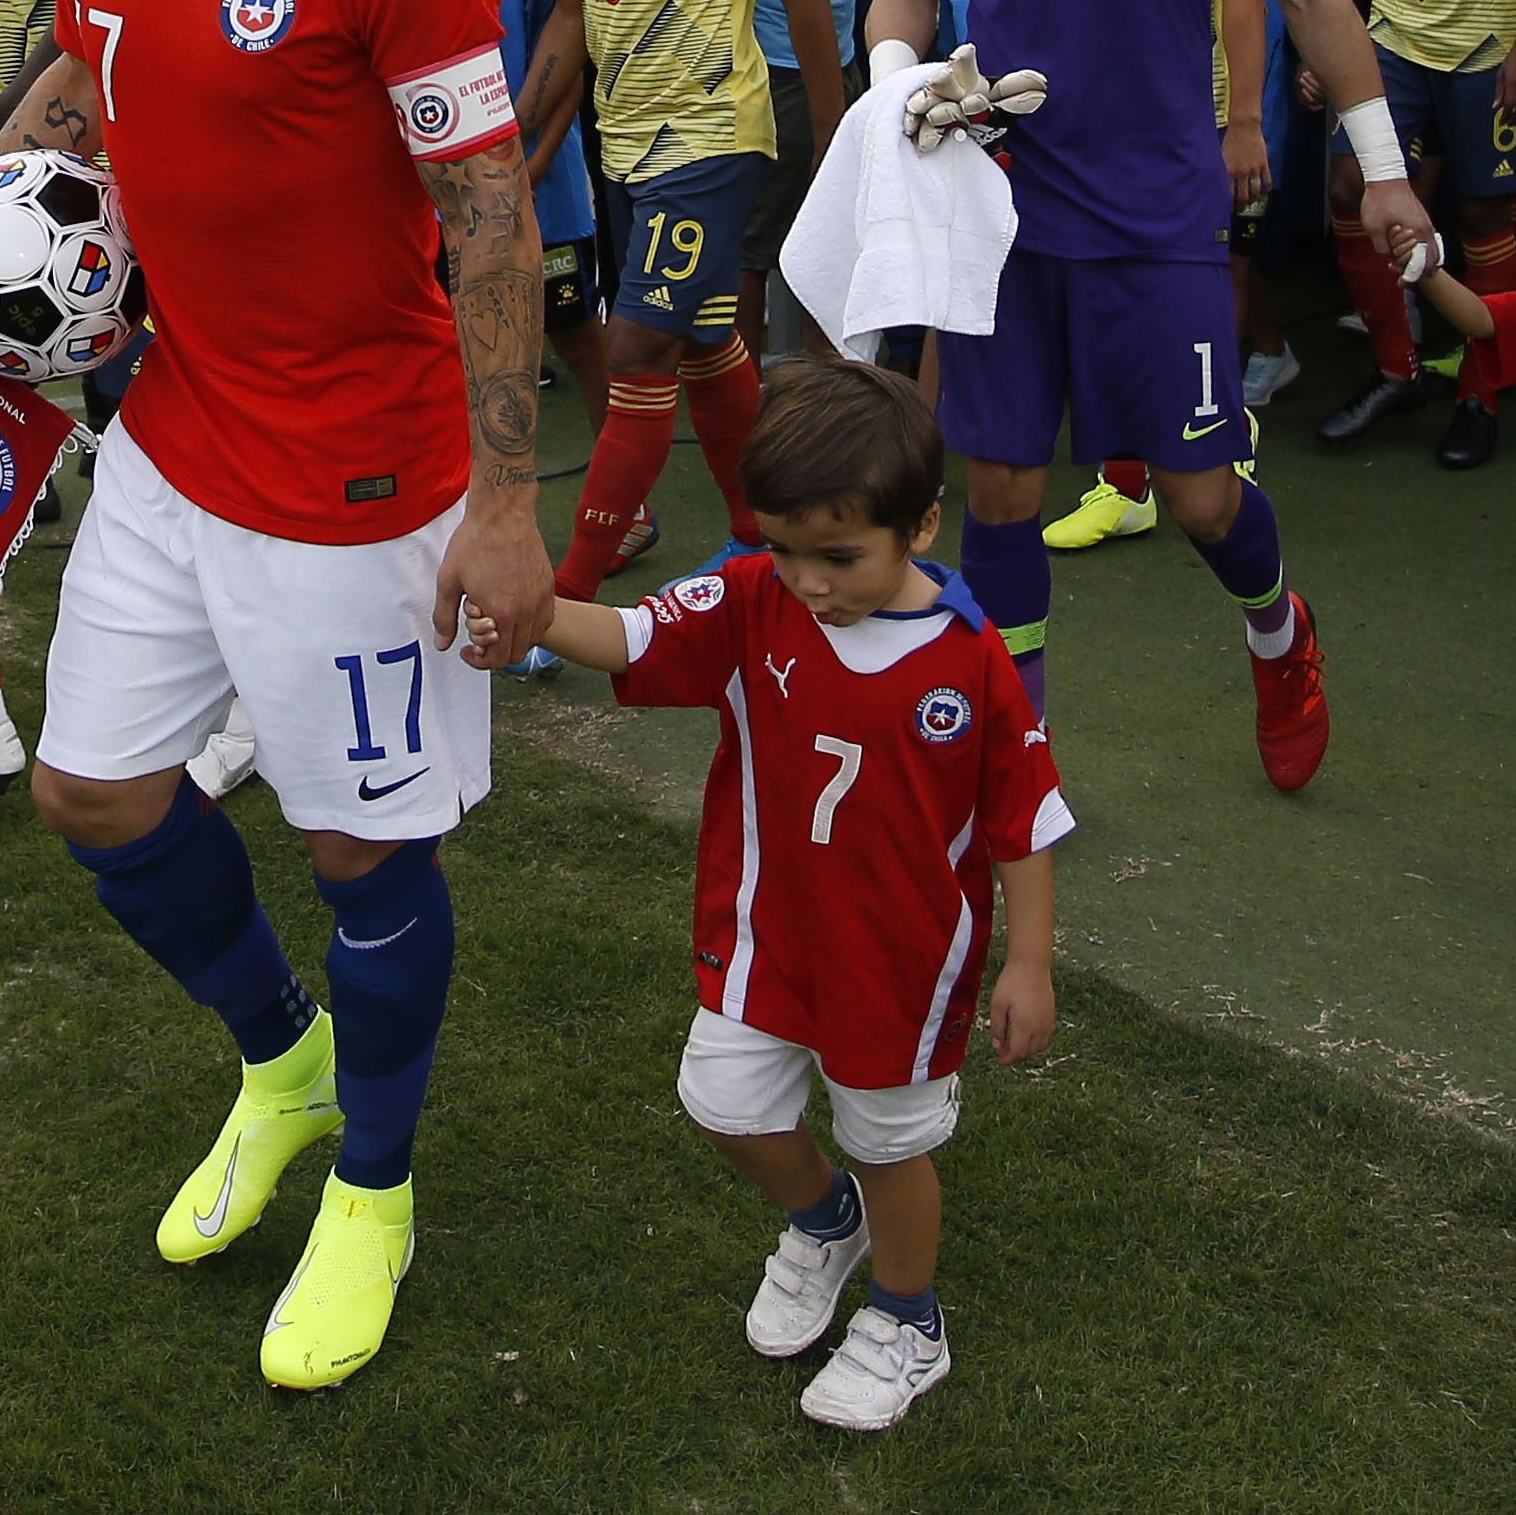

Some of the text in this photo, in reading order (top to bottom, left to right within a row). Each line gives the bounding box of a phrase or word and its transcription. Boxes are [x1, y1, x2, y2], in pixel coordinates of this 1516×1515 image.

[231, 34, 272, 52] DE CHILE
[458, 86, 470, 98] EL
[643, 211, 705, 281] 19
[542, 255, 575, 275] CRC
[642, 294, 674, 312] adidas
[1193, 342, 1219, 417] 1
[0, 448, 14, 492] FUTBOL
[585, 508, 619, 526] FCF
[334, 639, 424, 762] 17
[810, 733, 863, 845] 7
